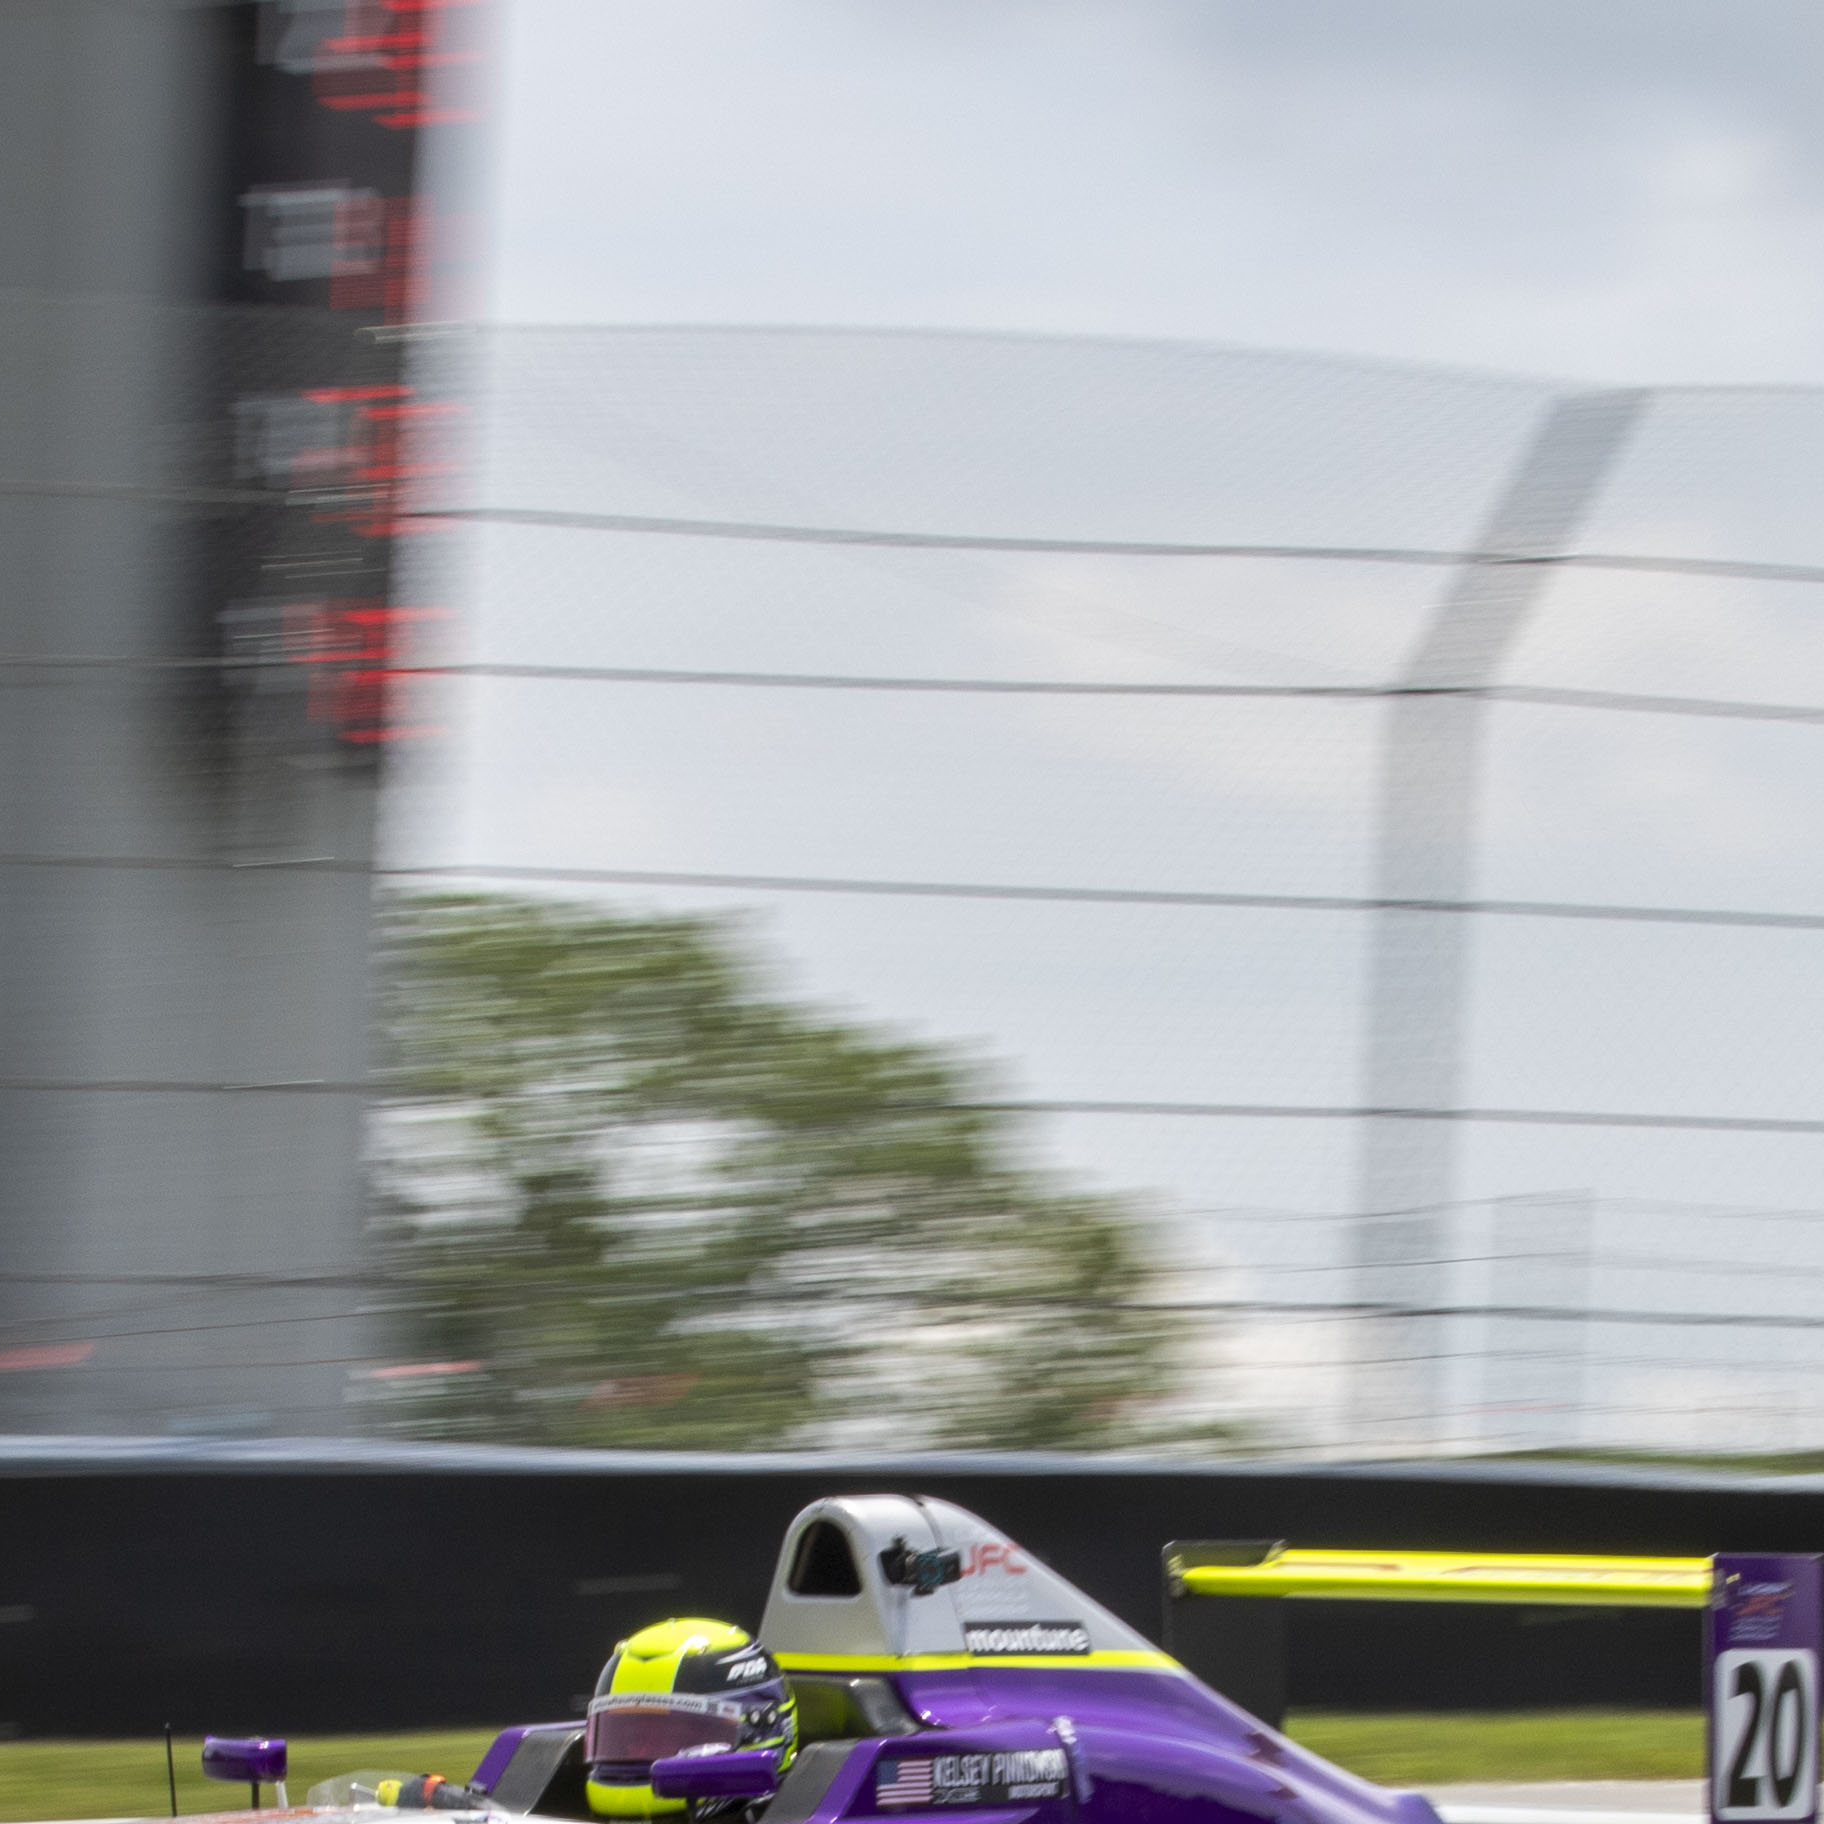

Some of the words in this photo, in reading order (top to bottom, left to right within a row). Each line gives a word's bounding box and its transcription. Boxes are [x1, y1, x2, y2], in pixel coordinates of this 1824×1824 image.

[966, 1623, 1090, 1651] mountune
[1724, 1658, 1808, 1809] 20
[934, 1754, 991, 1787] KELSEY
